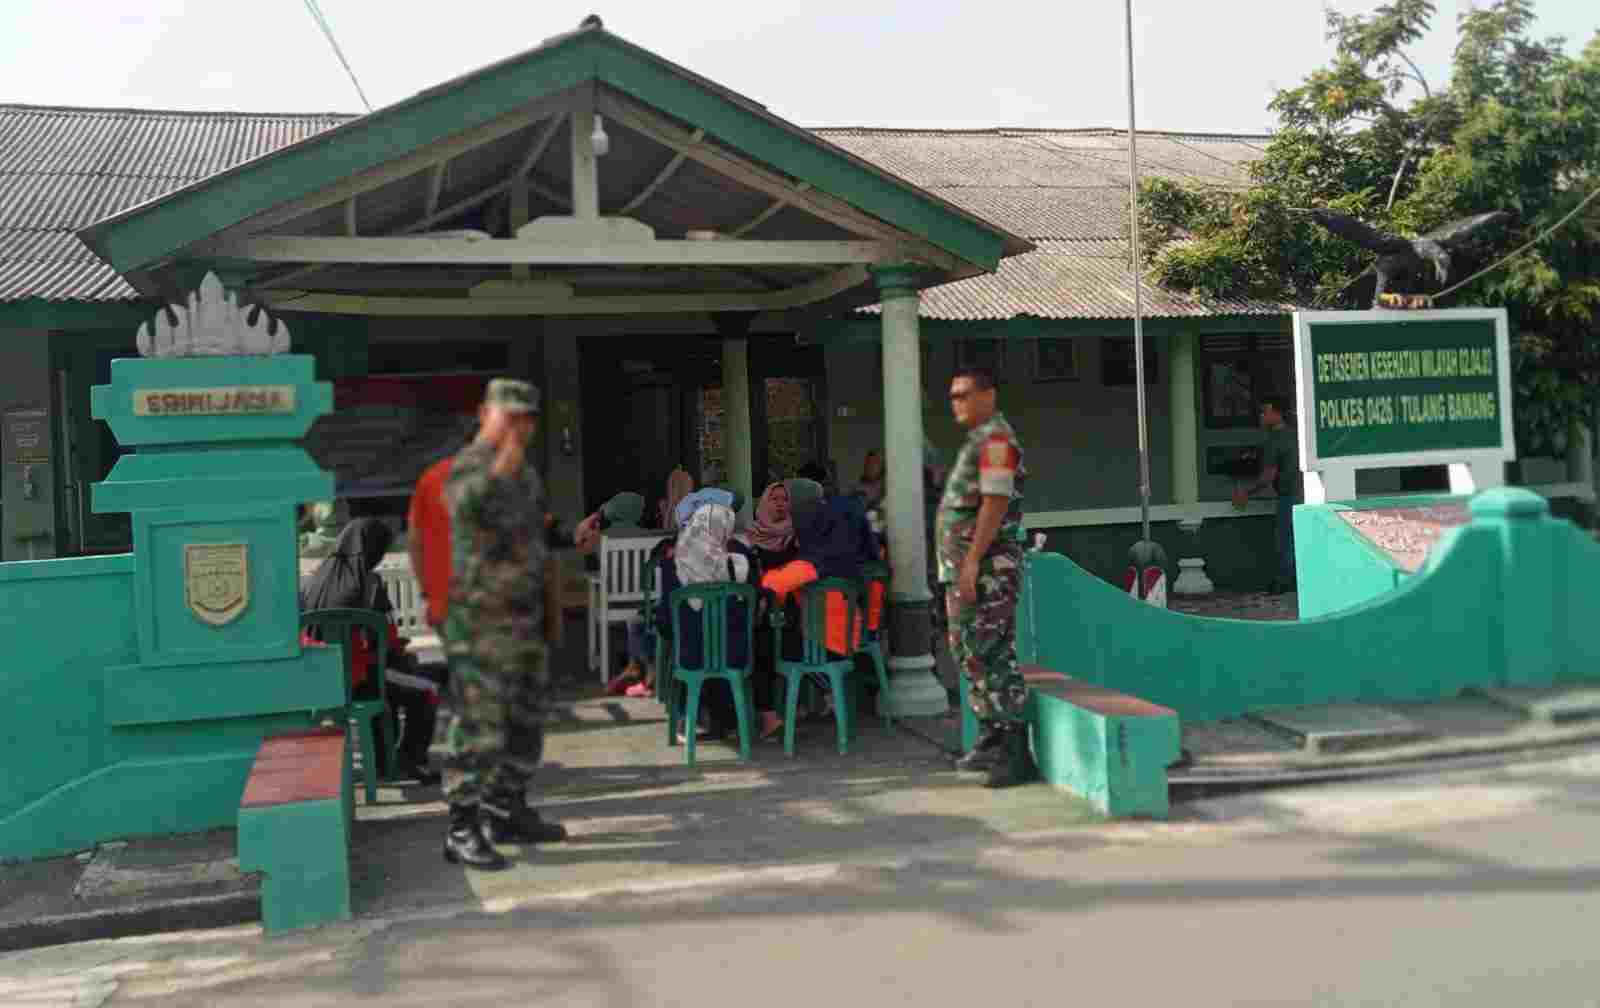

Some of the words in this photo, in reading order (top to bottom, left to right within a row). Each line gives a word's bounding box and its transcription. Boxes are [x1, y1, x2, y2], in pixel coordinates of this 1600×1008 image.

[1317, 352, 1369, 383] DETASEMEN
[1371, 350, 1420, 380] KESEHATAN
[1422, 348, 1457, 378] WILAYAH
[1320, 397, 1364, 429] POLKES
[1366, 395, 1392, 425] 0426
[1400, 393, 1445, 424] TULANG
[1447, 391, 1496, 422] BAWANG
